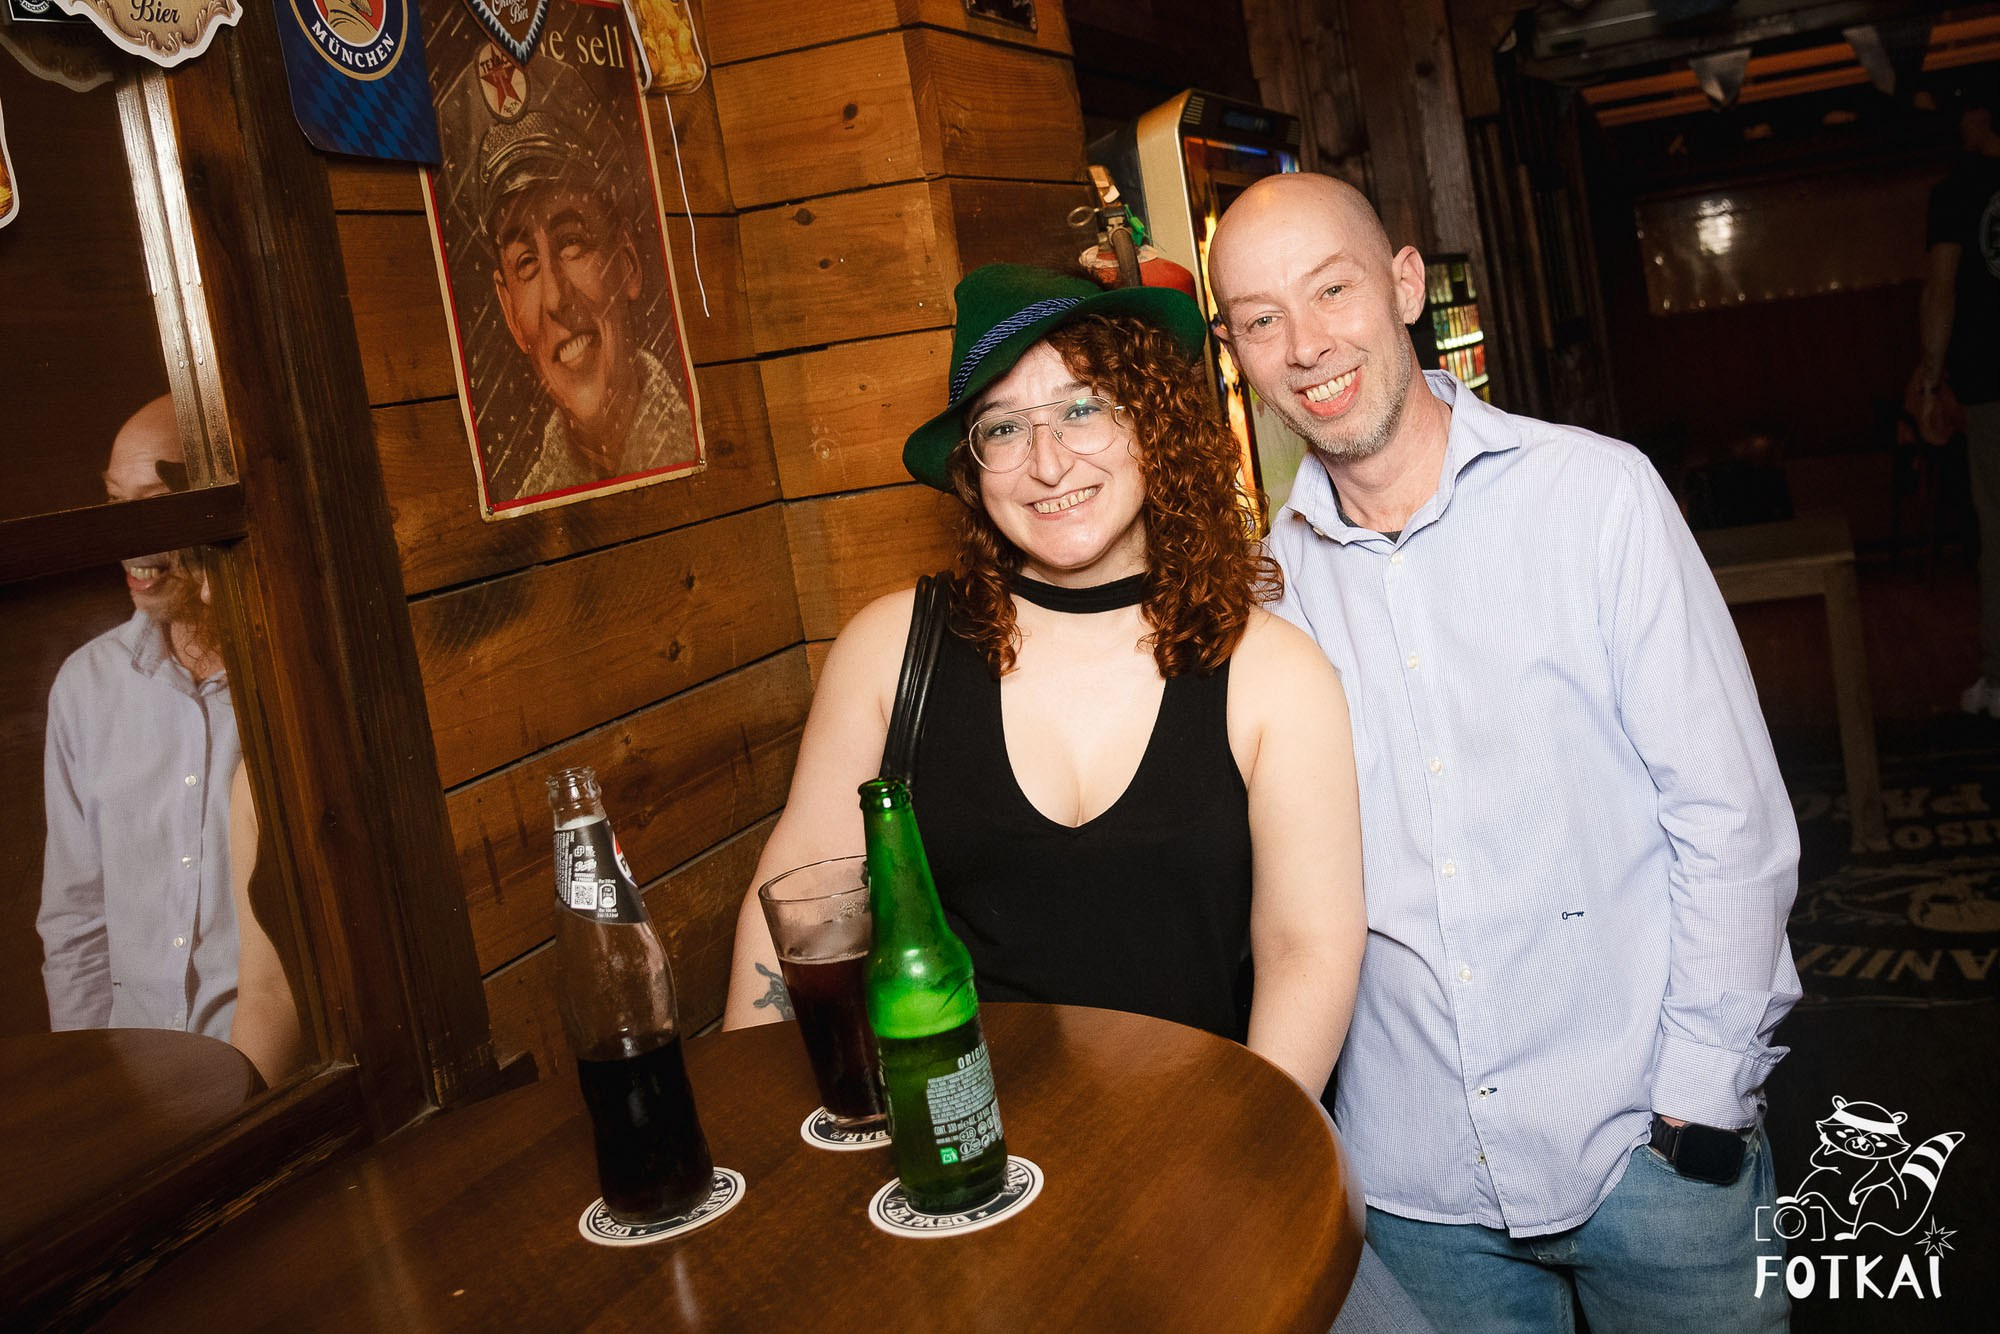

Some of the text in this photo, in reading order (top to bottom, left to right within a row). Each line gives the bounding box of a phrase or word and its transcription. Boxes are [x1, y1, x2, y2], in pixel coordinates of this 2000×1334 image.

[130, 0, 181, 24] Bier
[311, 20, 395, 68] MÜNCHEN
[576, 24, 625, 69] sell
[594, 1215, 633, 1237] PASO
[907, 1214, 972, 1229] PASO
